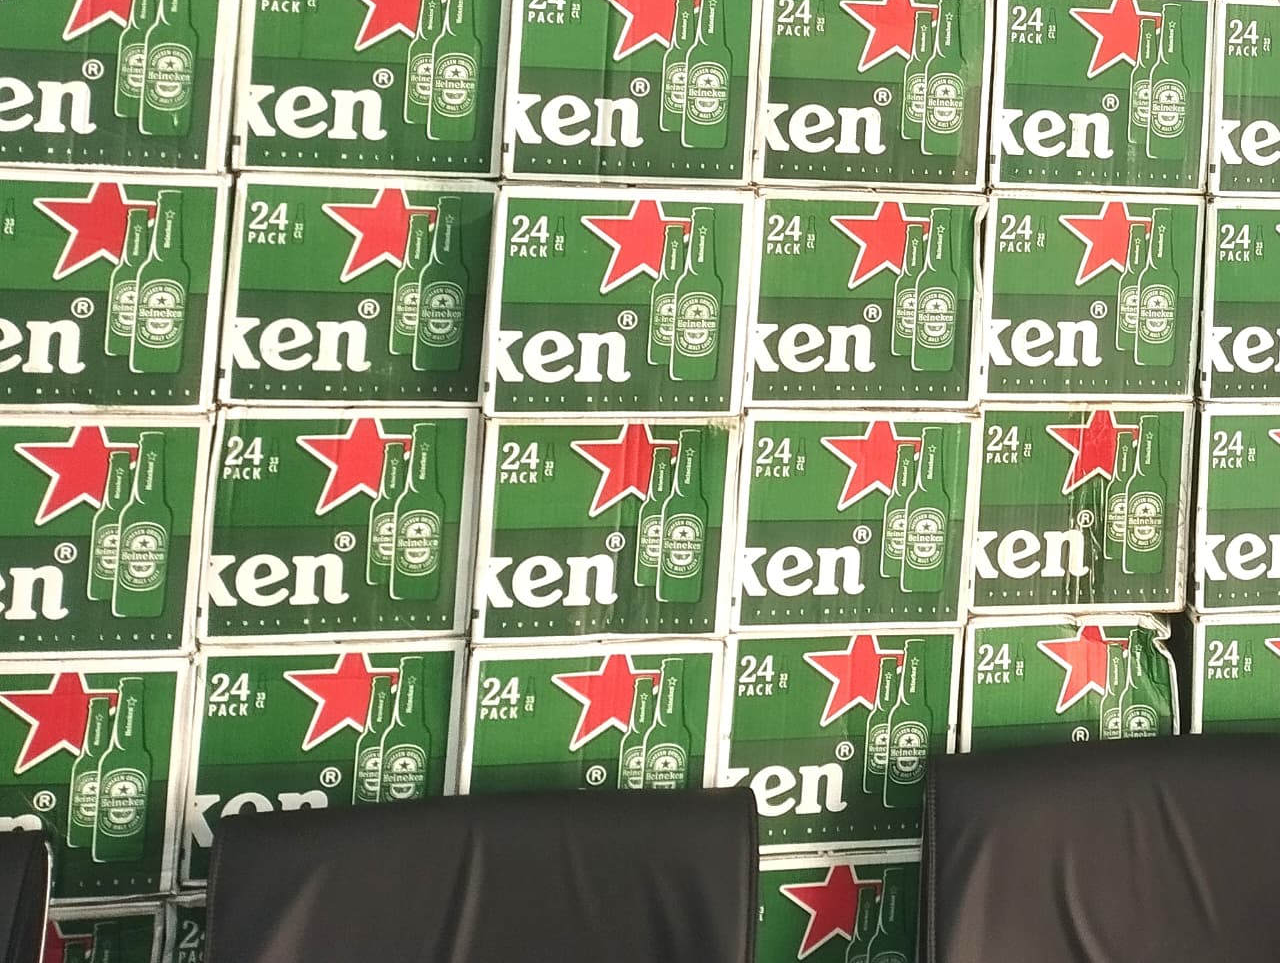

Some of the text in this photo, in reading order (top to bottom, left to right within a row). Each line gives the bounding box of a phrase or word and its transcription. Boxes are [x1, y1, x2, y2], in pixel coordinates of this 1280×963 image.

[262, 0, 300, 12] PACK
[528, 11, 564, 24] PACK
[777, 25, 810, 37] PACK
[249, 201, 288, 230] 24
[248, 231, 286, 244] PACK
[511, 215, 549, 243] 24
[510, 245, 547, 257] PACK
[225, 436, 263, 465] 24
[756, 438, 792, 464] 24
[1213, 431, 1244, 456] 24
[501, 442, 539, 469] 24
[224, 467, 261, 479] PACK
[501, 472, 537, 483] PACK
[739, 655, 774, 683] 24
[209, 673, 250, 702] 24
[209, 703, 248, 716] PACK
